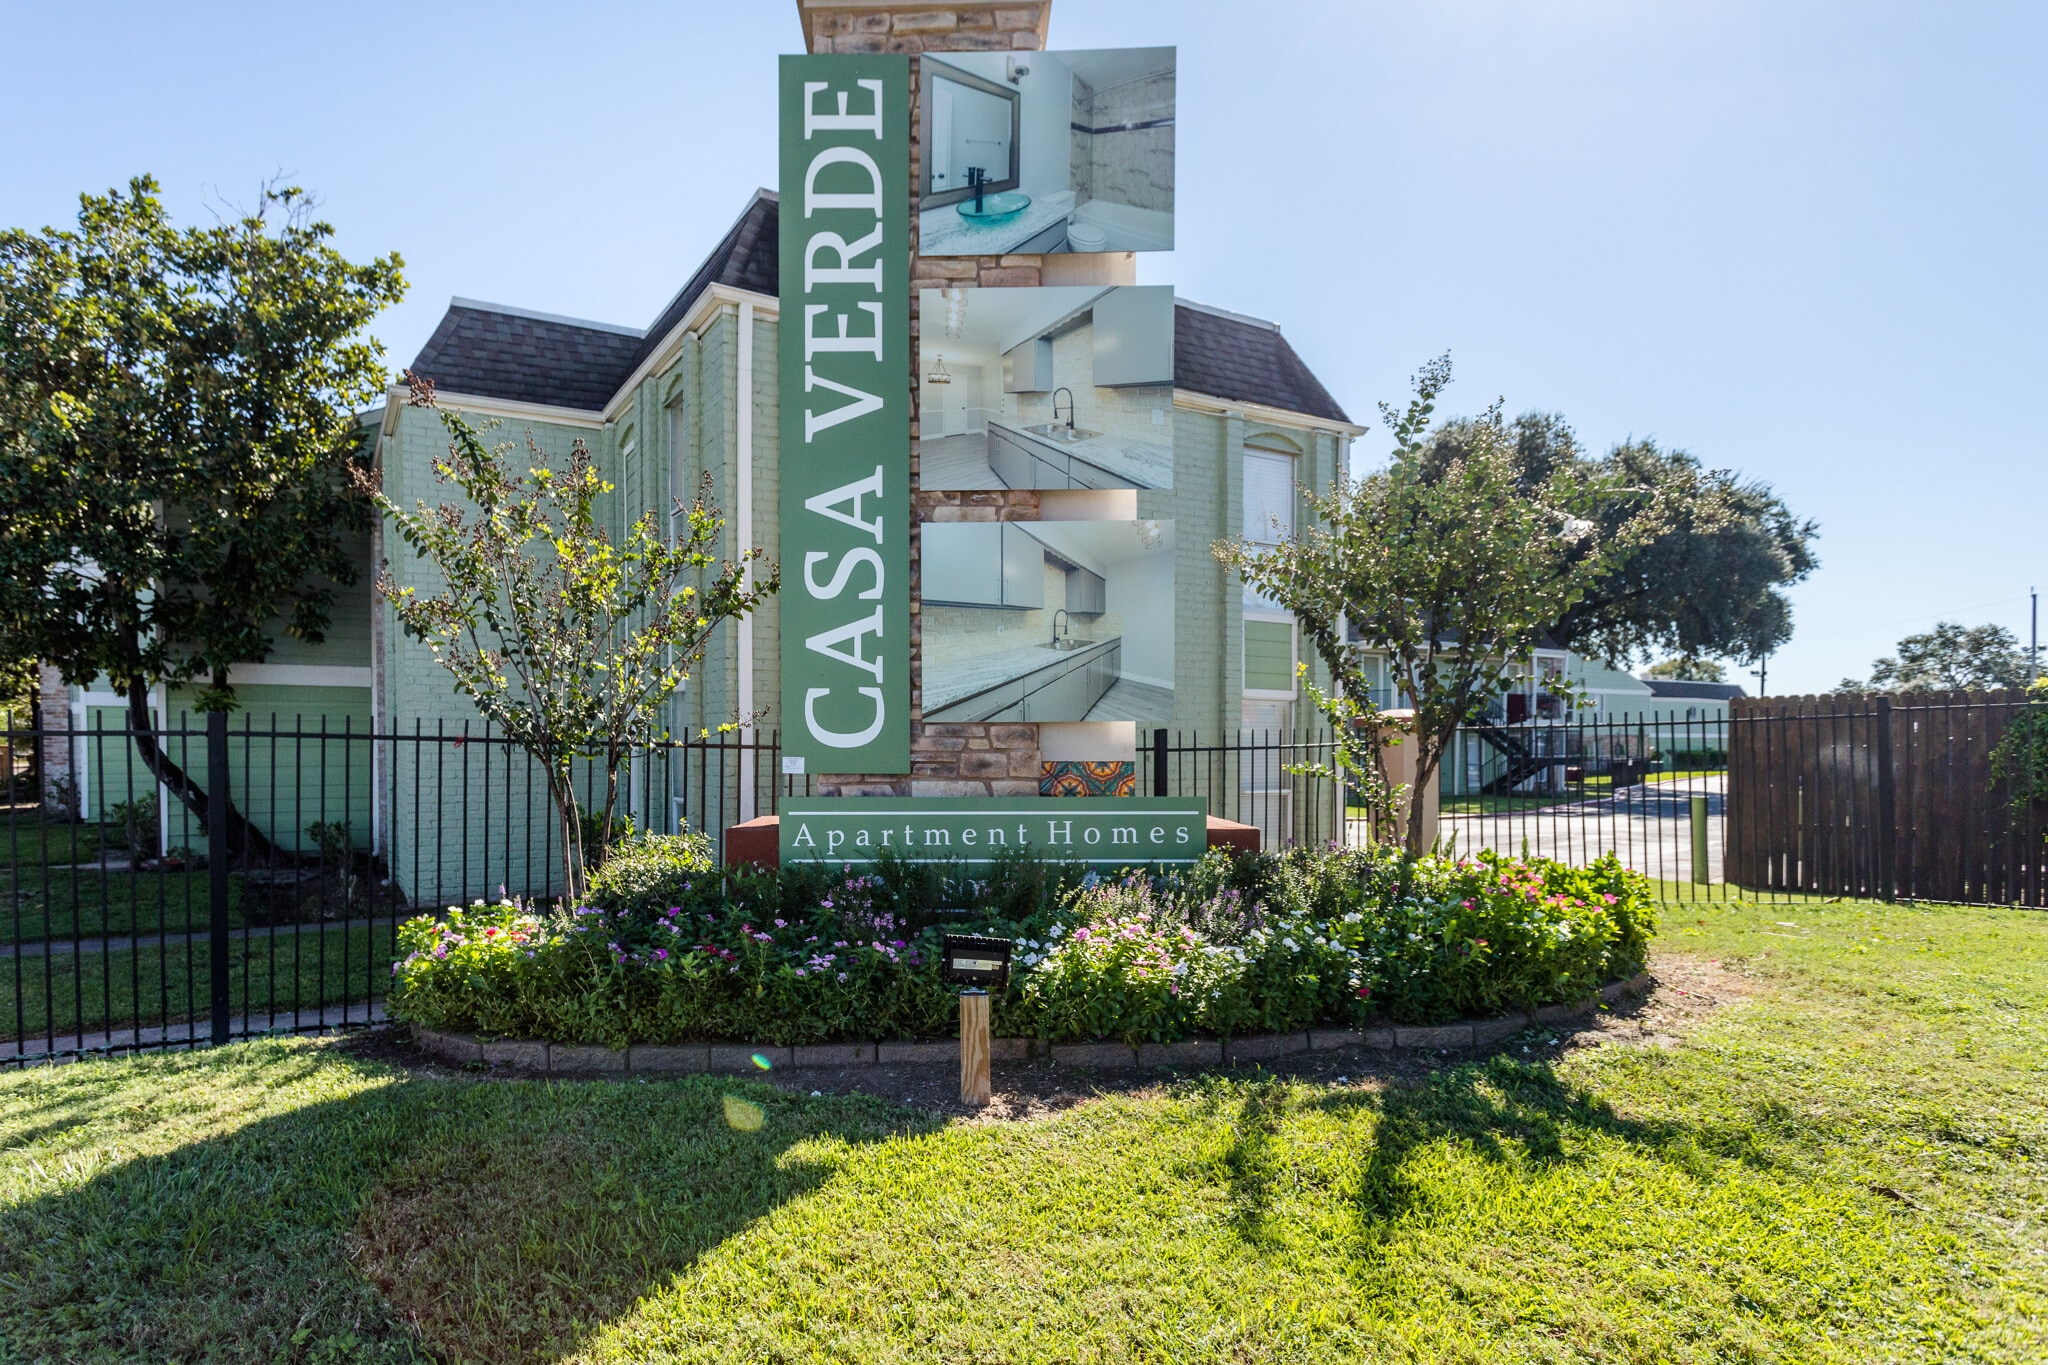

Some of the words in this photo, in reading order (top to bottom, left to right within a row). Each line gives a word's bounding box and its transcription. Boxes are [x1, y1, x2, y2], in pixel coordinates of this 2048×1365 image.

[804, 79, 884, 443] VERDE
[804, 465, 885, 748] CASA
[792, 822, 1028, 855] Apartment
[1047, 820, 1190, 845] Homes
